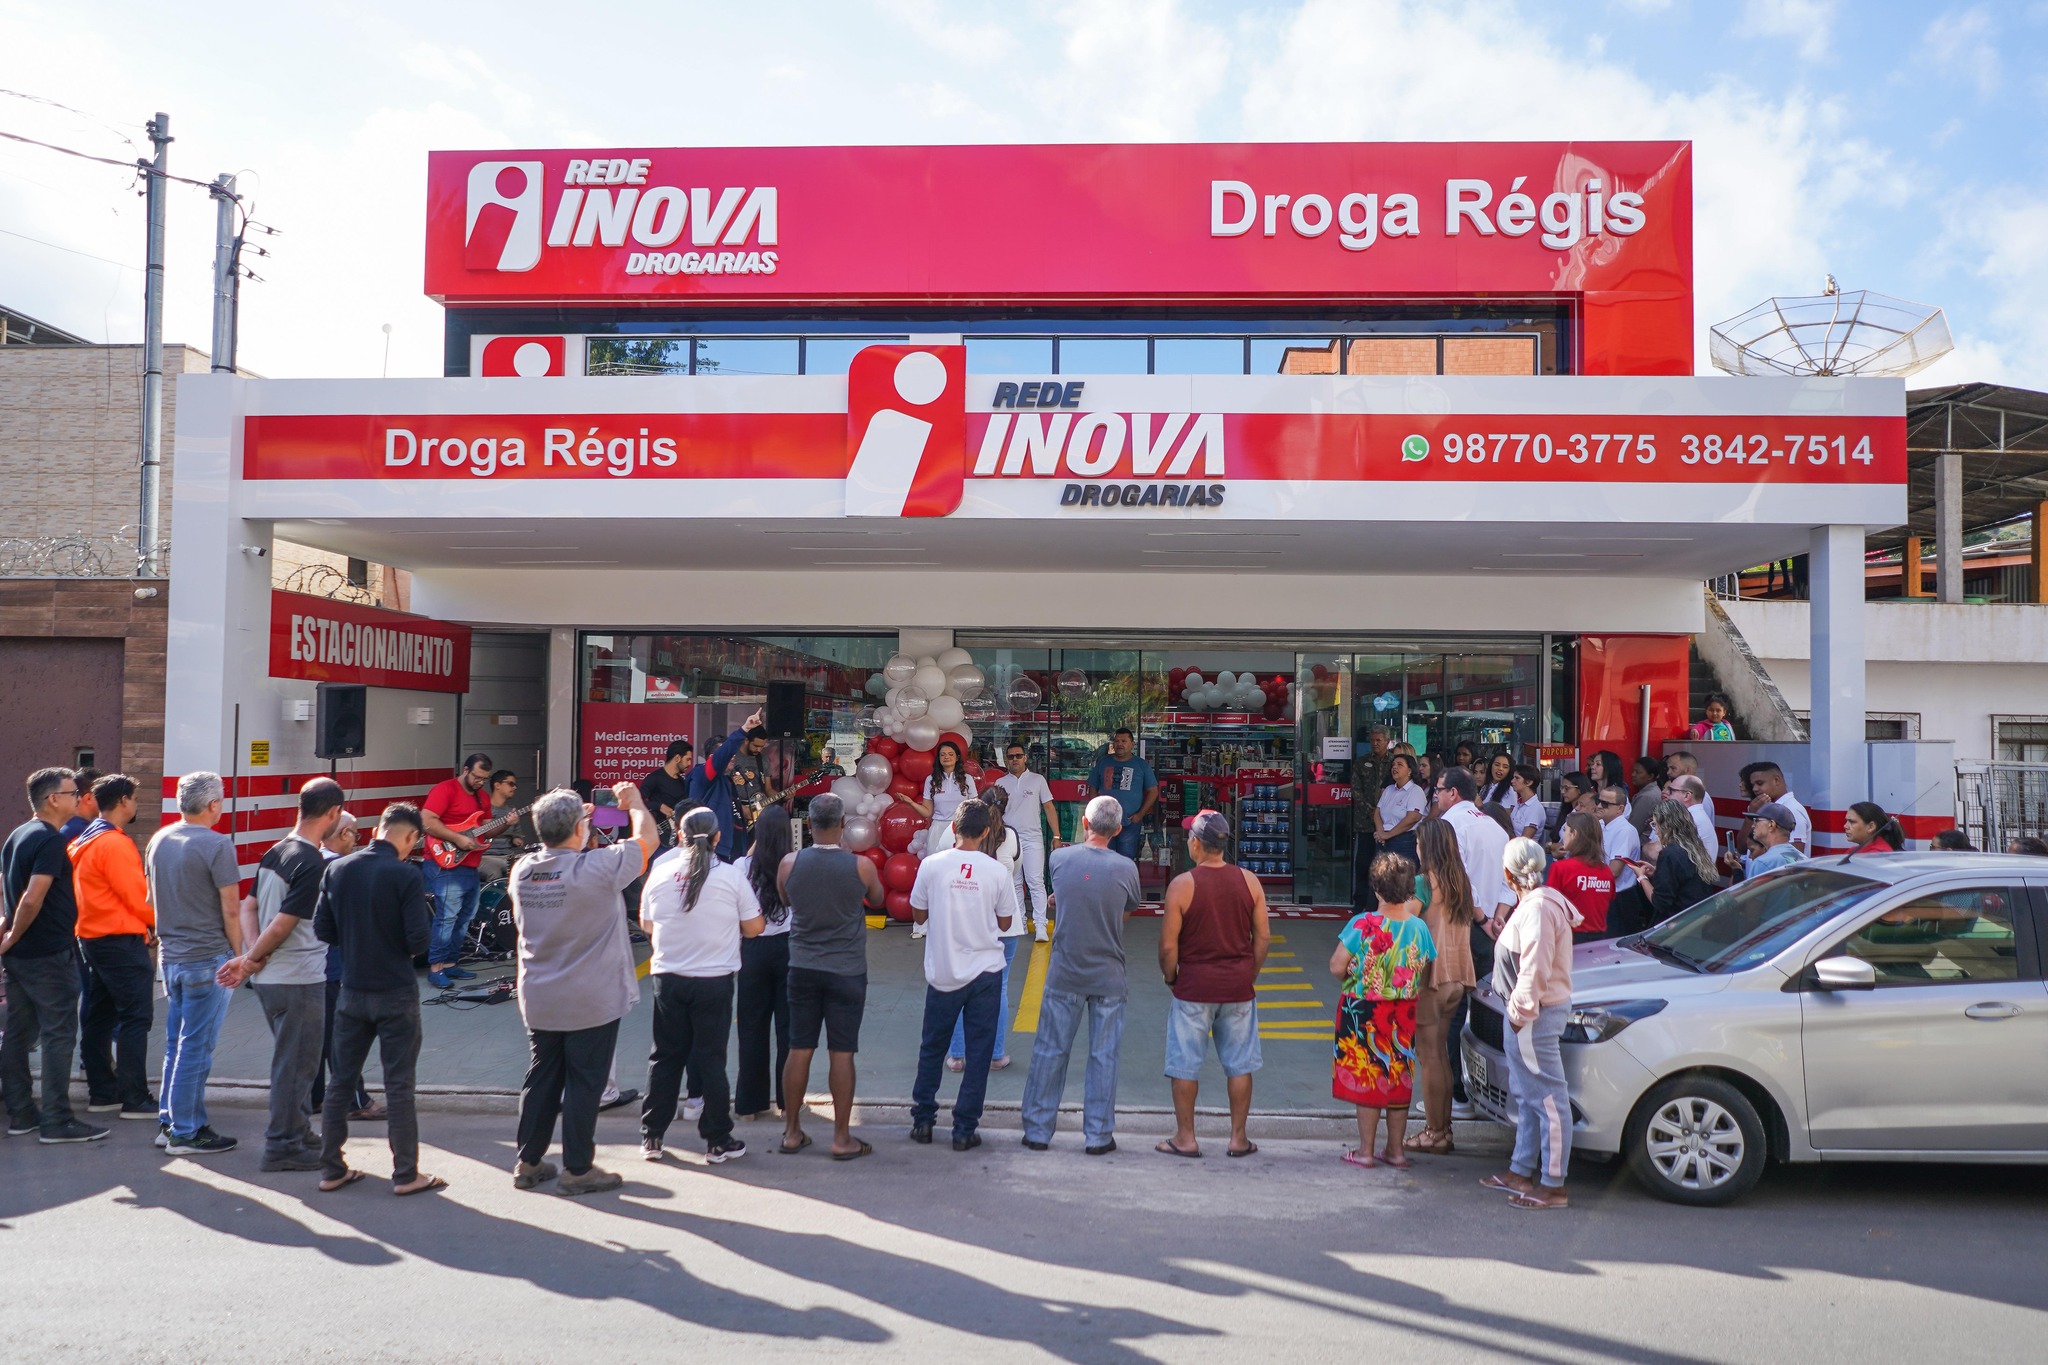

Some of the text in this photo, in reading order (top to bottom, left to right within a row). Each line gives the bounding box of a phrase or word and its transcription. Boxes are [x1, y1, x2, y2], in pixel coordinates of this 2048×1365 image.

[563, 158, 651, 186] REDE
[547, 186, 778, 247] INOVA
[1210, 175, 1647, 252] Droga Régis
[625, 251, 778, 276] DROGARIAS
[992, 381, 1085, 408] REDE
[384, 427, 679, 477] Droga Régis
[973, 412, 1226, 477] INOVA
[1442, 433, 1875, 465] 98770-3775 3842-7514
[1060, 484, 1227, 507] DROGARIAS
[290, 613, 454, 678] ESTACIONAMENTO
[594, 731, 689, 742] Medicamentos
[594, 758, 666, 769] que popula
[605, 746, 648, 757] preços
[1541, 747, 1574, 756] POPCORN
[594, 771, 620, 780] com
[1587, 880, 1611, 889] INOVA
